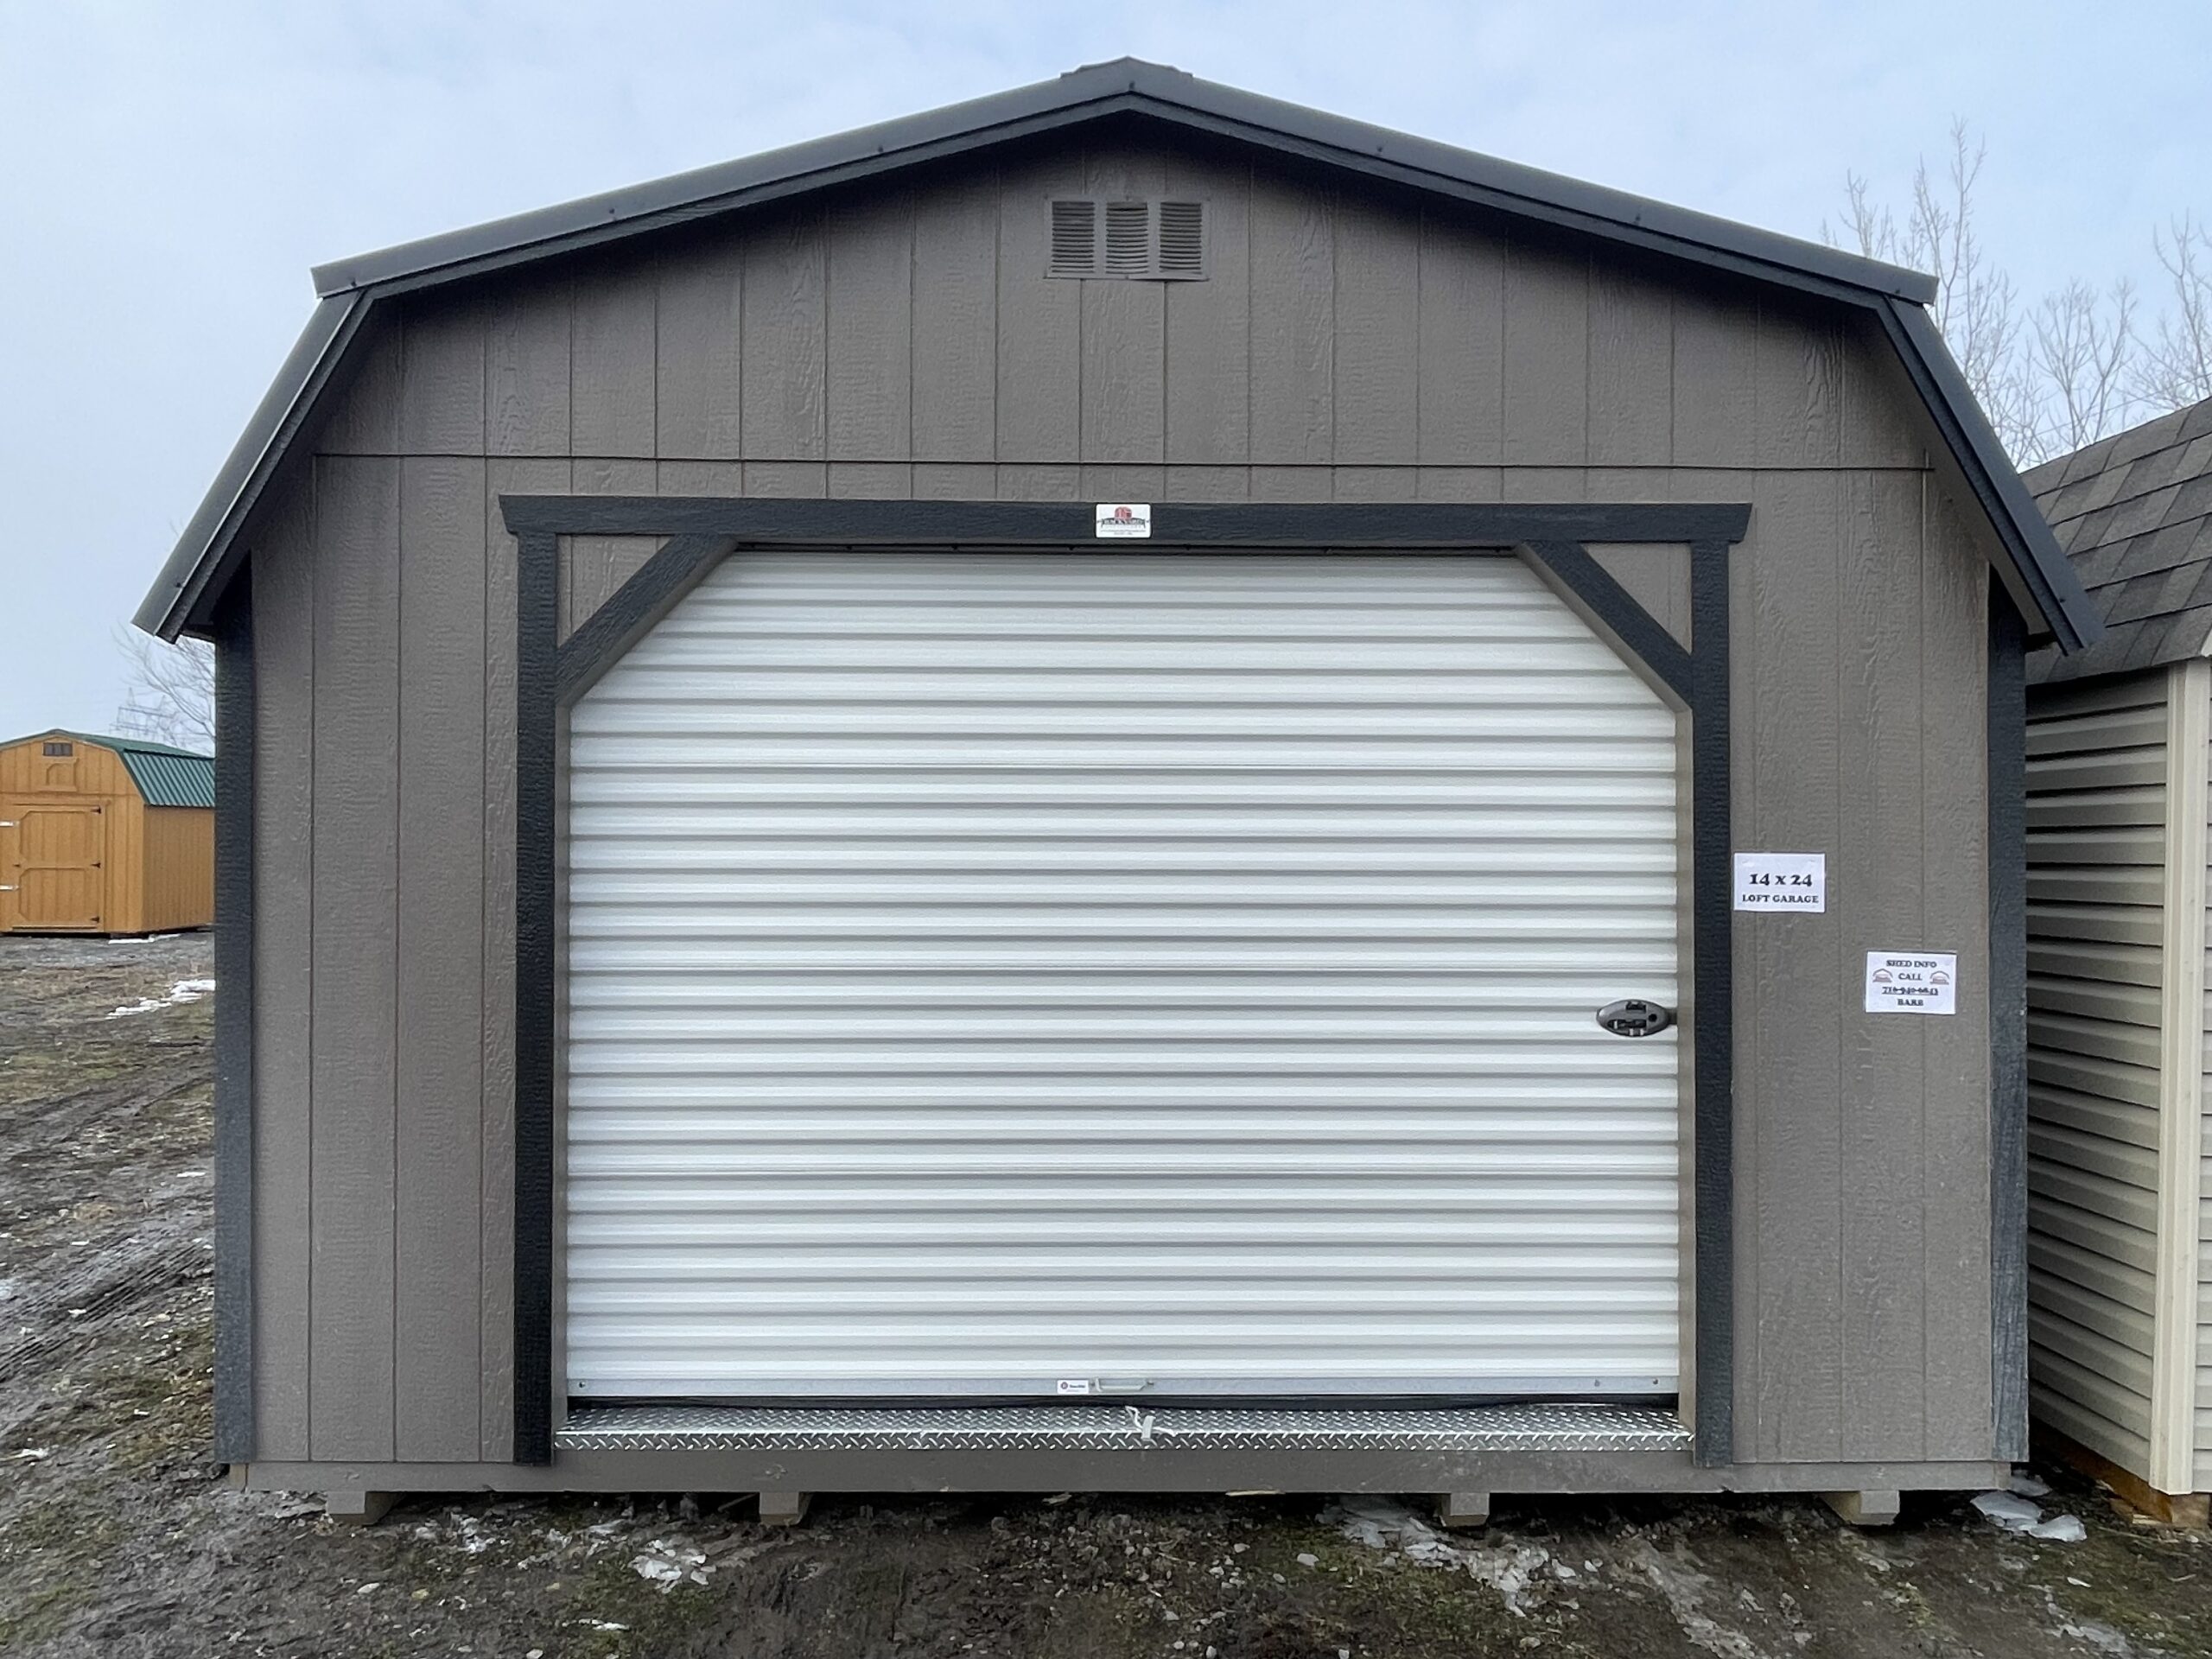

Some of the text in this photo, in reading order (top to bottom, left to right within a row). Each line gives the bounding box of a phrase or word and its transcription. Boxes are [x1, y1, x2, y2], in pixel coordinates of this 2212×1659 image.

[1749, 873, 1813, 887] 14 x 24
[1742, 893, 1819, 904] LOFT GARAGE
